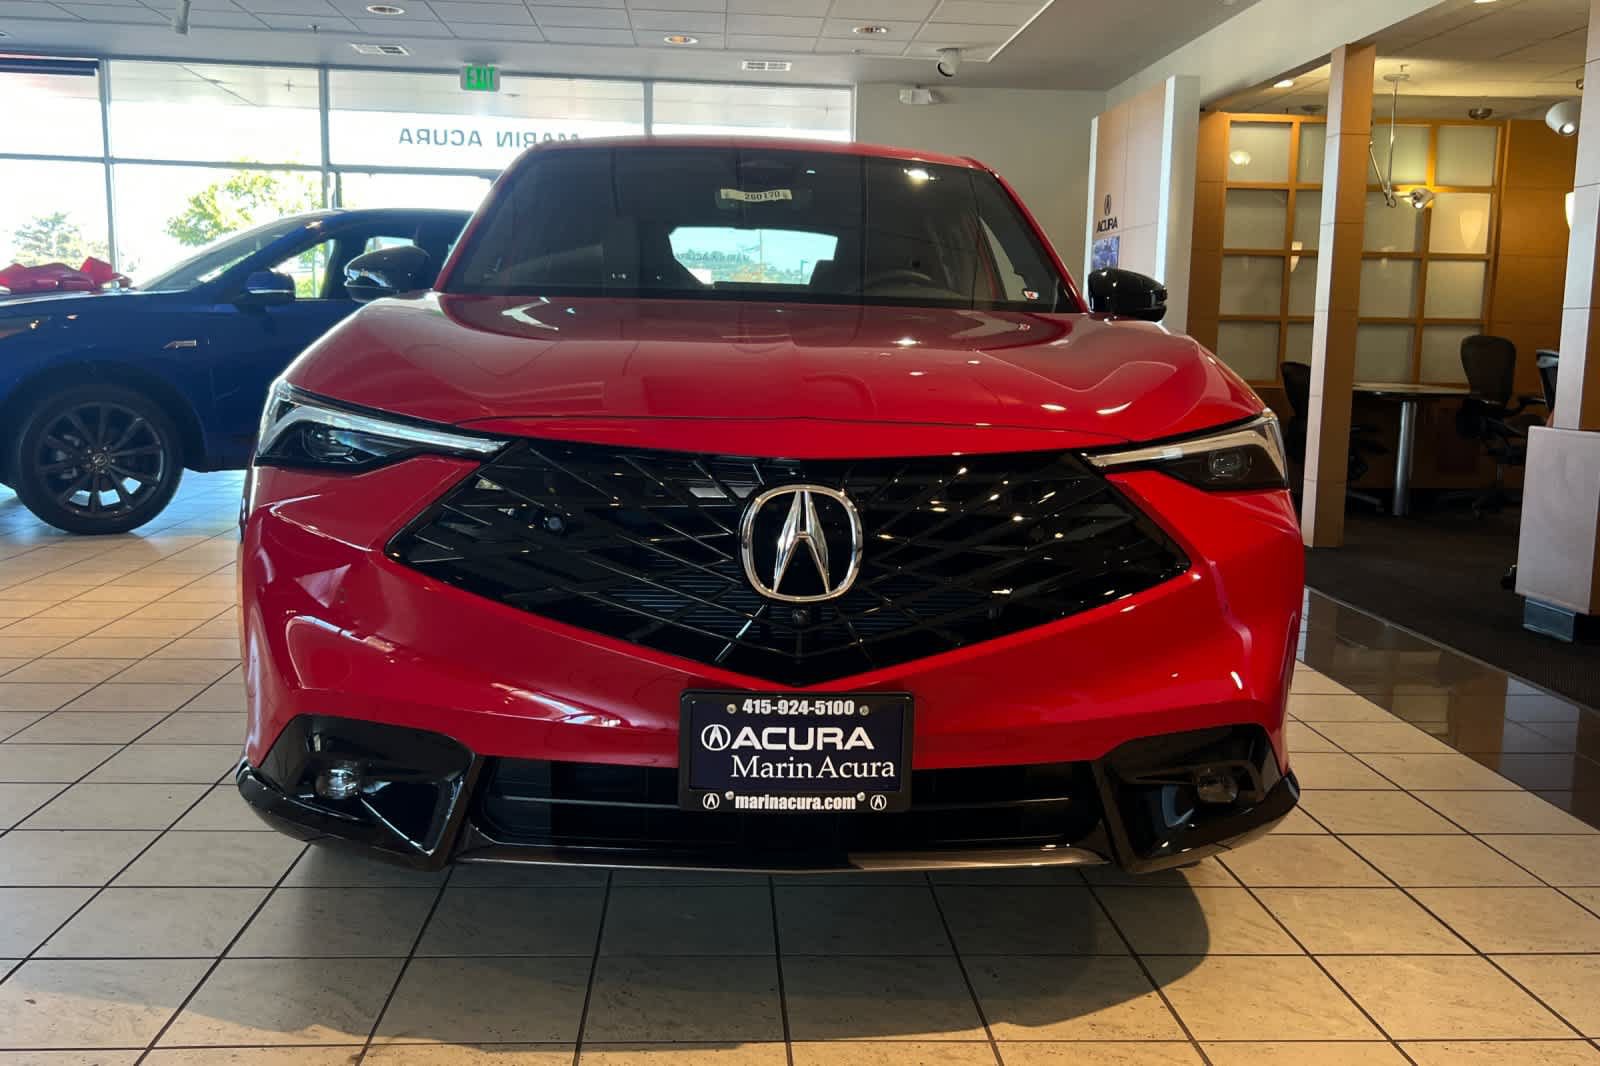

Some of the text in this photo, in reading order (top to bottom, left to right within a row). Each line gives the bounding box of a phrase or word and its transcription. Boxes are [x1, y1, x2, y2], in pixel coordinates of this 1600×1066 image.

[465, 66, 496, 90] EXIT
[1096, 216, 1119, 233] ACURA
[742, 698, 855, 716] 415-924-5100
[730, 726, 875, 751] ACURA
[730, 754, 896, 778] Marin Acura
[734, 793, 856, 810] marinacura.com
